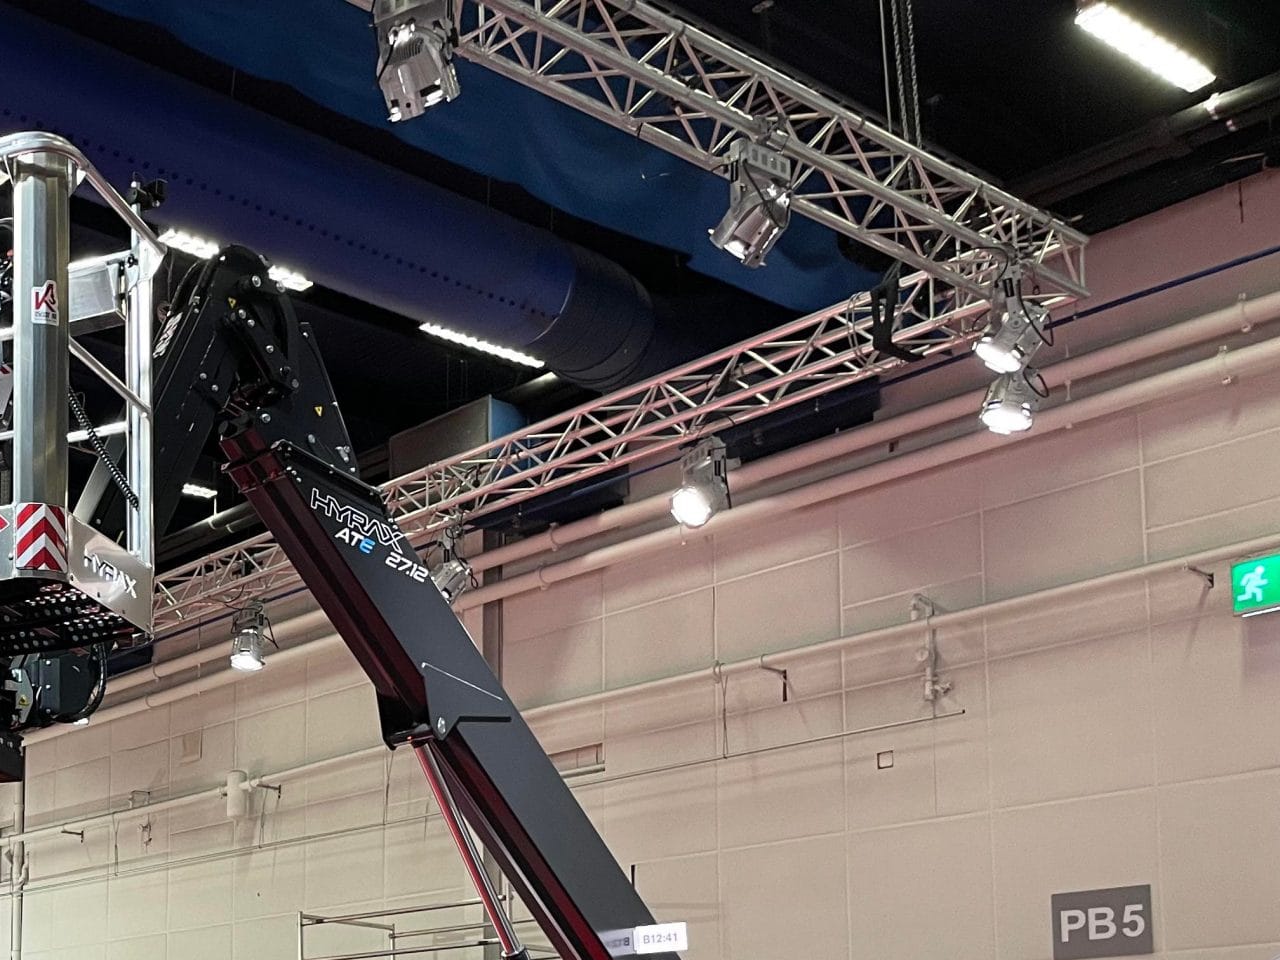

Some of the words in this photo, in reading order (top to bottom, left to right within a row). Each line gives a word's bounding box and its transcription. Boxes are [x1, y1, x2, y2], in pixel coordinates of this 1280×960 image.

[310, 487, 404, 554] HYRAX
[83, 548, 138, 599] HYRAX
[334, 527, 376, 554] ATE
[385, 551, 429, 583] 27.12
[643, 932, 678, 945] B12:41
